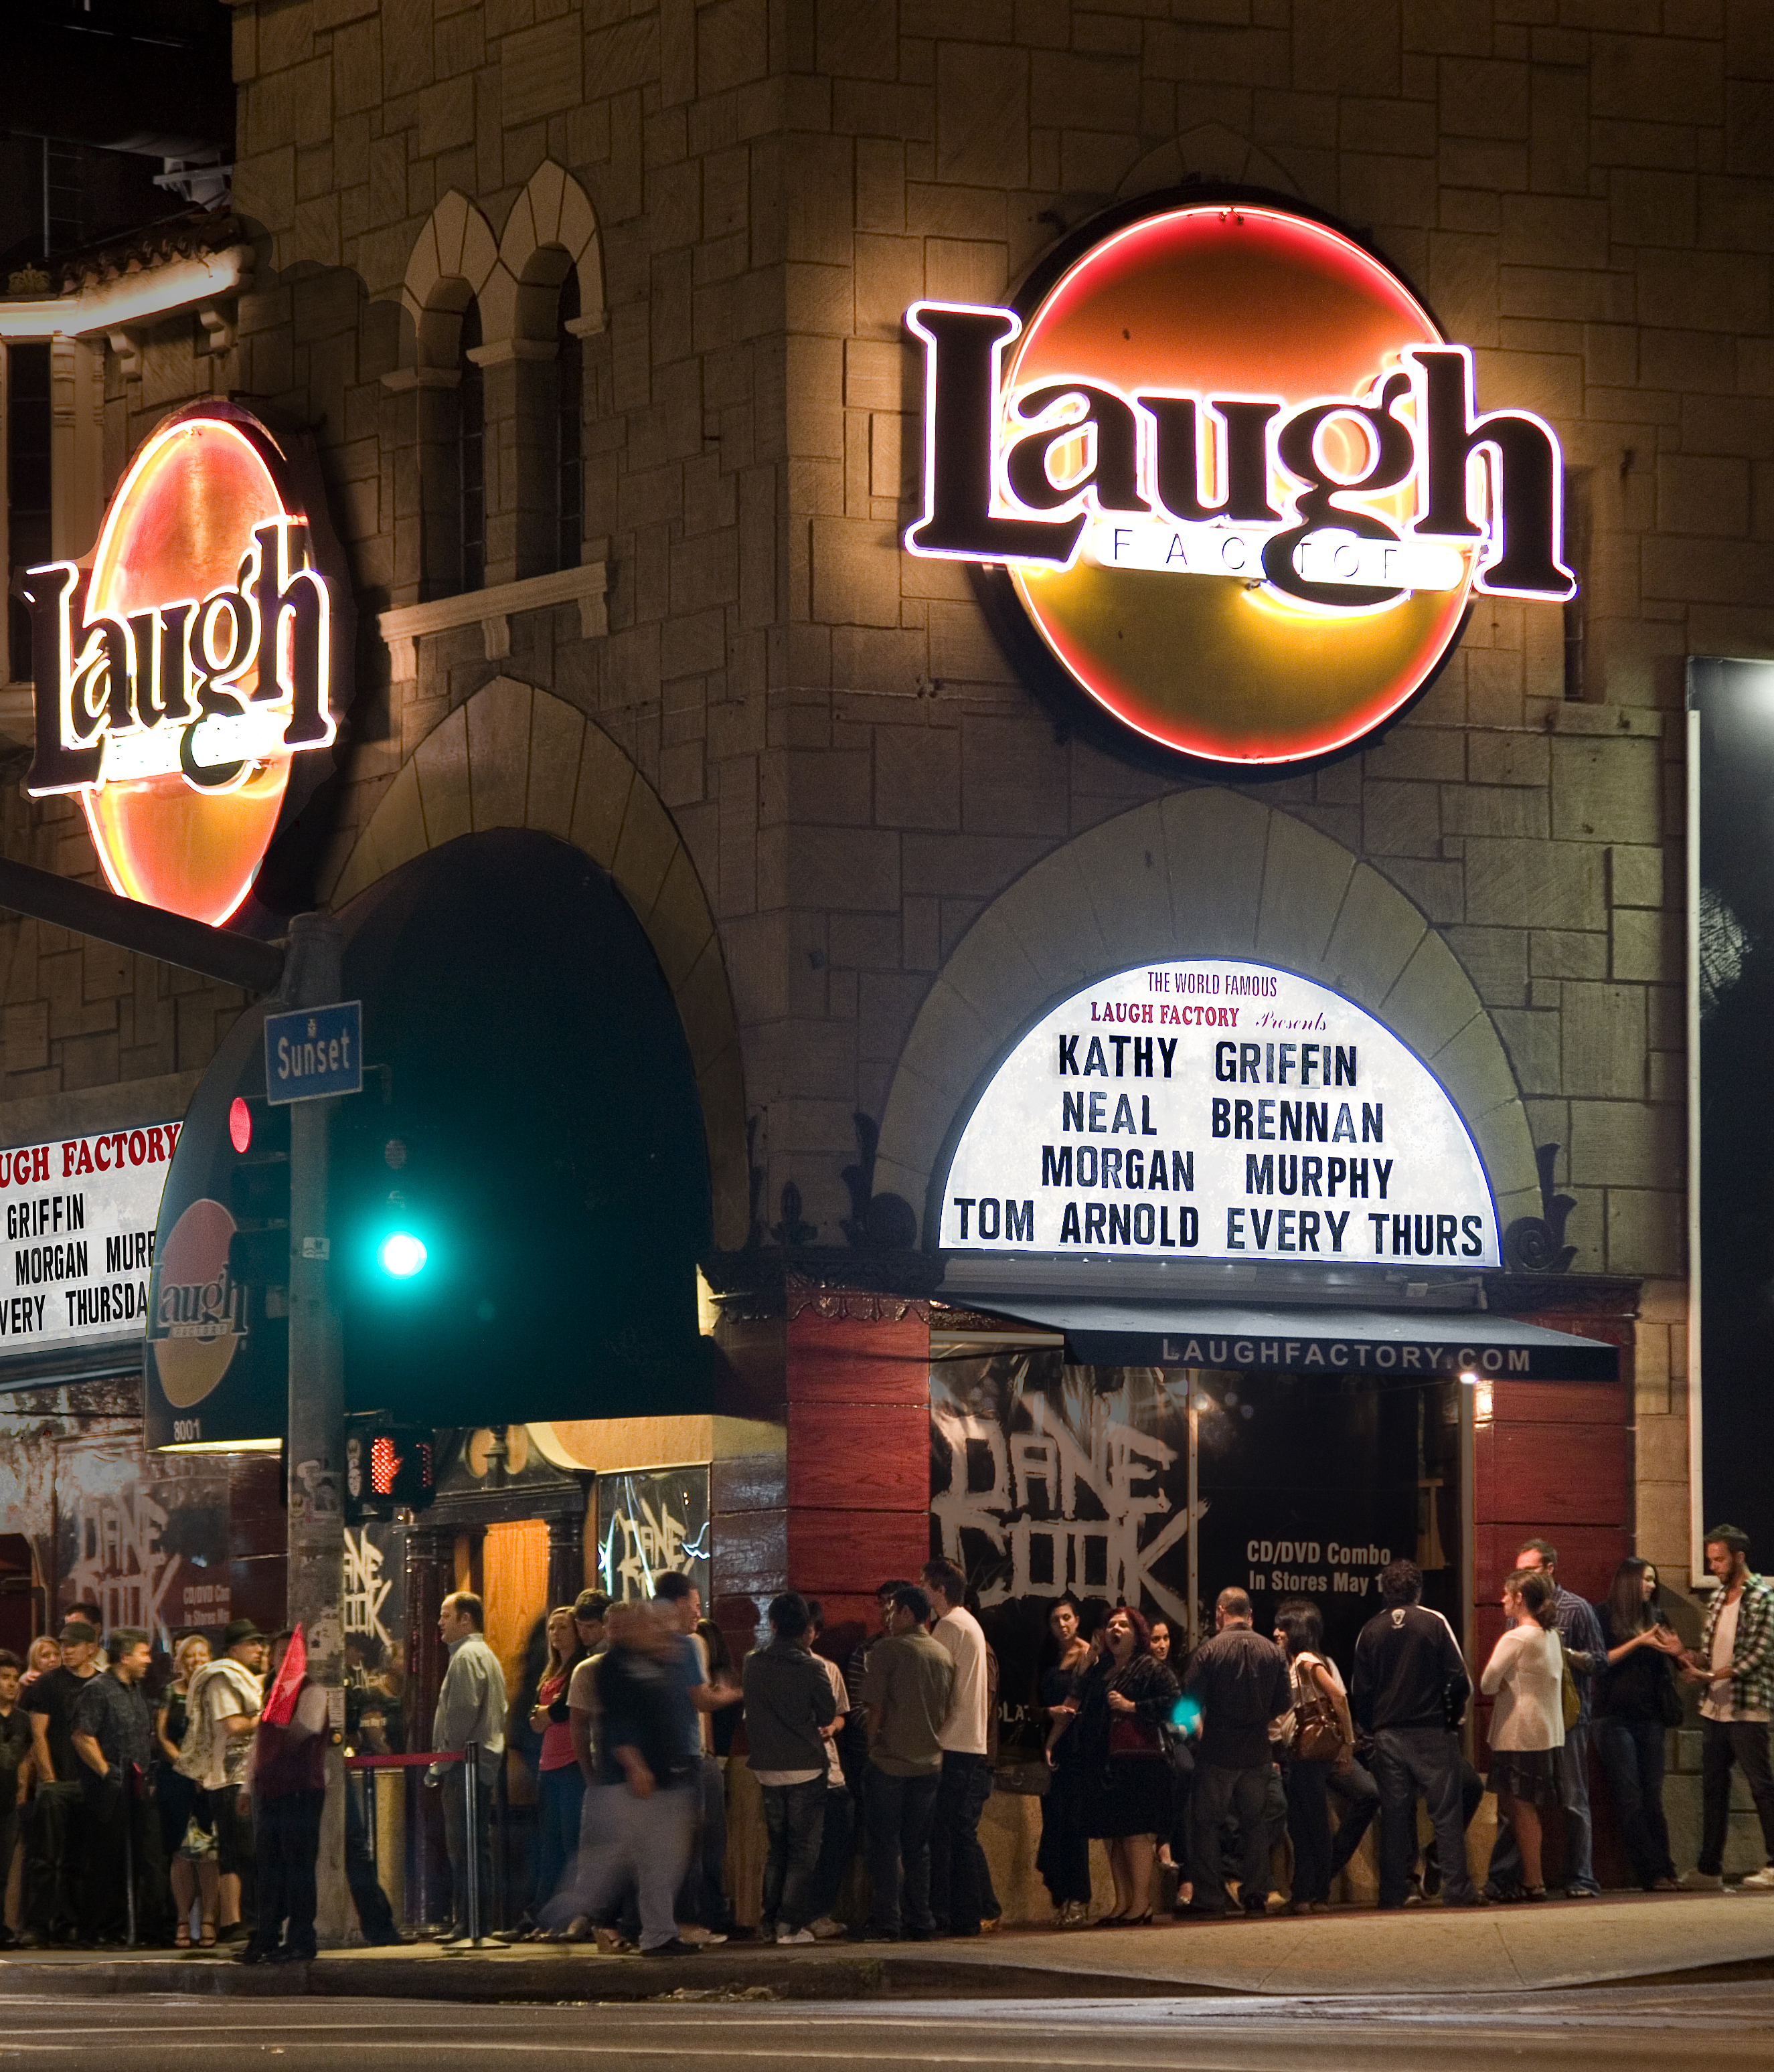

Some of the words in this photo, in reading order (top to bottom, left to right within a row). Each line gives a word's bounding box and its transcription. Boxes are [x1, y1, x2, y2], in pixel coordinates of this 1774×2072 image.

[905, 300, 1577, 614] Laugh
[24, 514, 337, 797] Laugh
[1147, 971, 1170, 992] THE
[1175, 972, 1220, 995] WORLD
[1225, 975, 1277, 997] FAMOUS
[1091, 1001, 1153, 1023] LAUGH
[1159, 1005, 1240, 1027] FACTORY
[1255, 1011, 1328, 1031] Presents
[277, 1027, 350, 1080] Sunset
[1058, 1034, 1178, 1079] KATHY
[1215, 1041, 1358, 1088] GRIFFIN
[1062, 1091, 1157, 1136] NEAL
[1212, 1098, 1384, 1144] BRENNAN
[0, 1146, 50, 1189] UGH
[61, 1123, 181, 1178] FACTORY
[1042, 1145, 1194, 1192] MORGAN
[1246, 1154, 1394, 1199] MURPHY
[7, 1193, 84, 1241] GRIFFIN
[954, 1197, 1035, 1242] TOM
[1060, 1202, 1200, 1249] ARNOLD
[1226, 1208, 1349, 1254] EVERY
[1368, 1213, 1483, 1258] THURS
[15, 1240, 88, 1286] MORGAN
[0, 1294, 46, 1336] VERY
[65, 1280, 148, 1327] THURSDA
[1162, 1338, 1531, 1372] LAUGHFACTORY.COM
[173, 1419, 201, 1442] 8001
[929, 1391, 1180, 1518] DANE
[1246, 1540, 1321, 1565] CD/DVD
[1327, 1543, 1391, 1565] Combo
[1249, 1570, 1266, 1590] In
[1271, 1570, 1327, 1591] Stores
[1334, 1572, 1369, 1597] May
